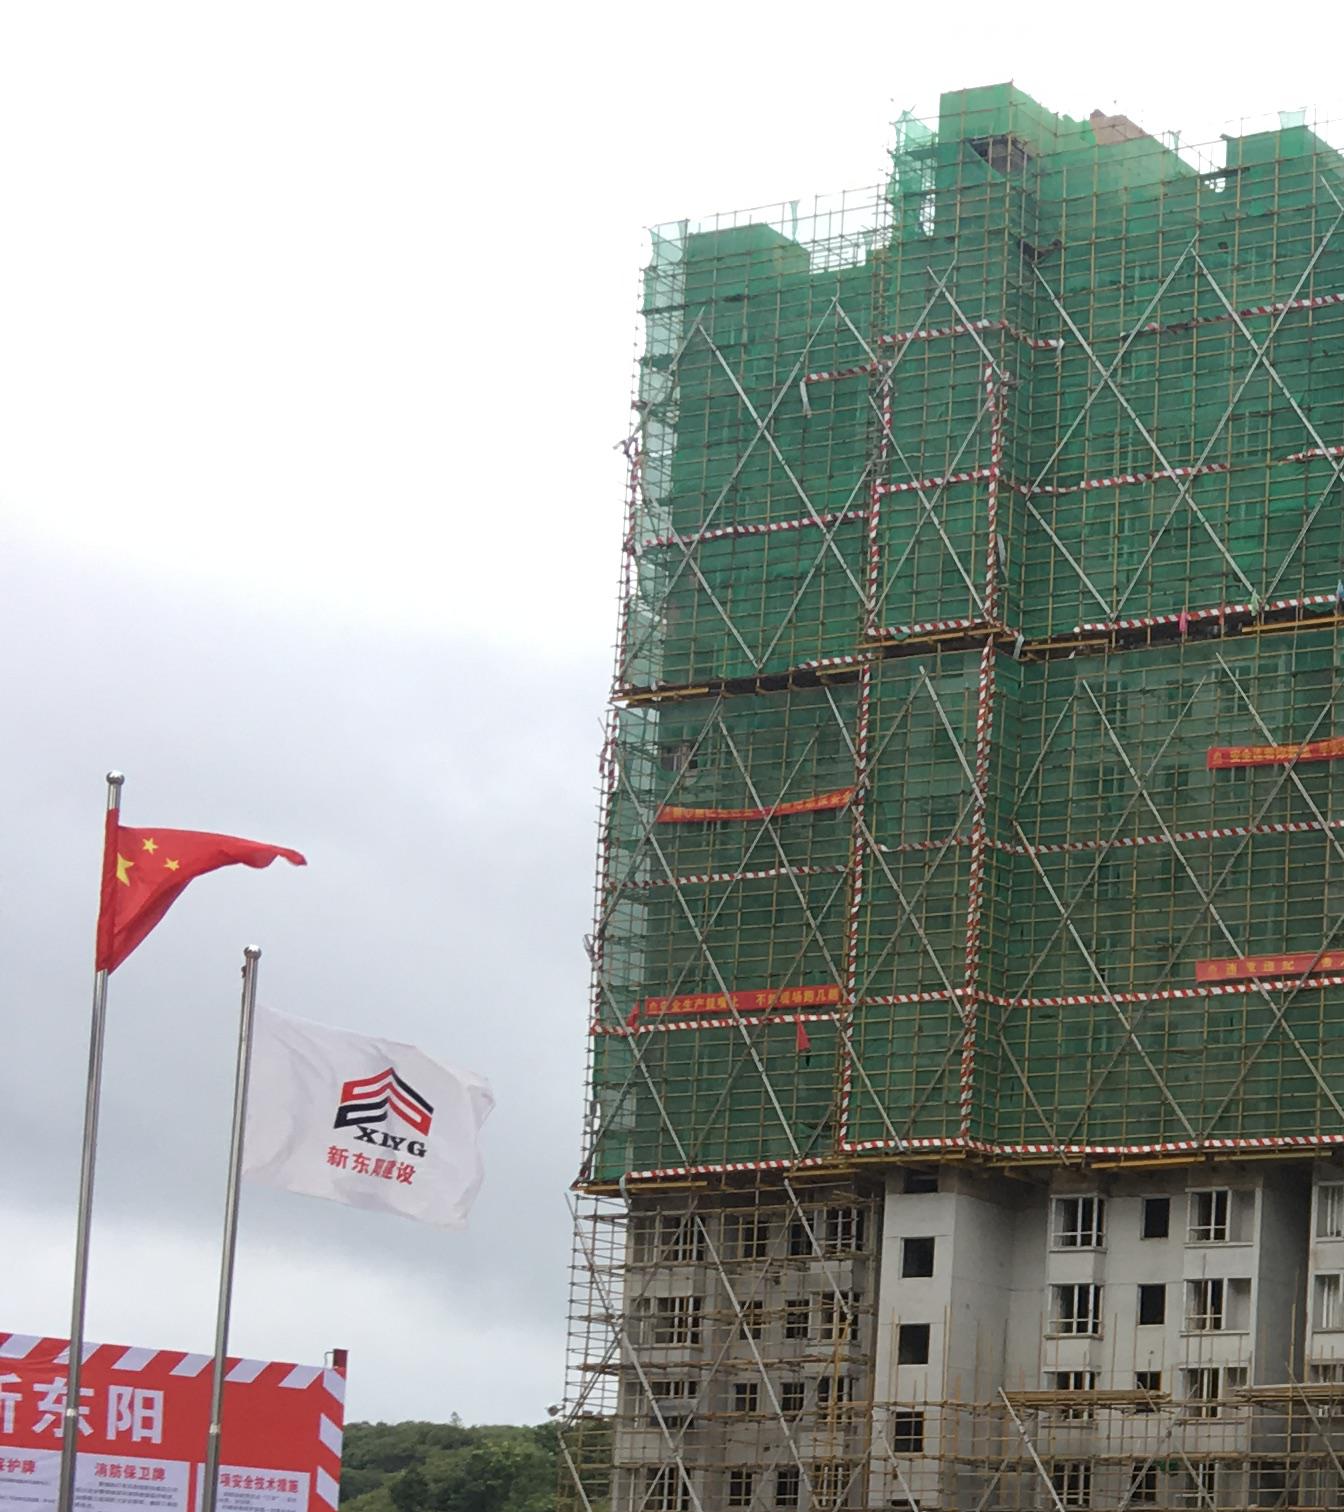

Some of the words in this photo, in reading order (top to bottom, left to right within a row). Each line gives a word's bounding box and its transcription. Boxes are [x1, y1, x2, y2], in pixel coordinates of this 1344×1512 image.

[219, 1474, 300, 1494] 项安全技术措施
